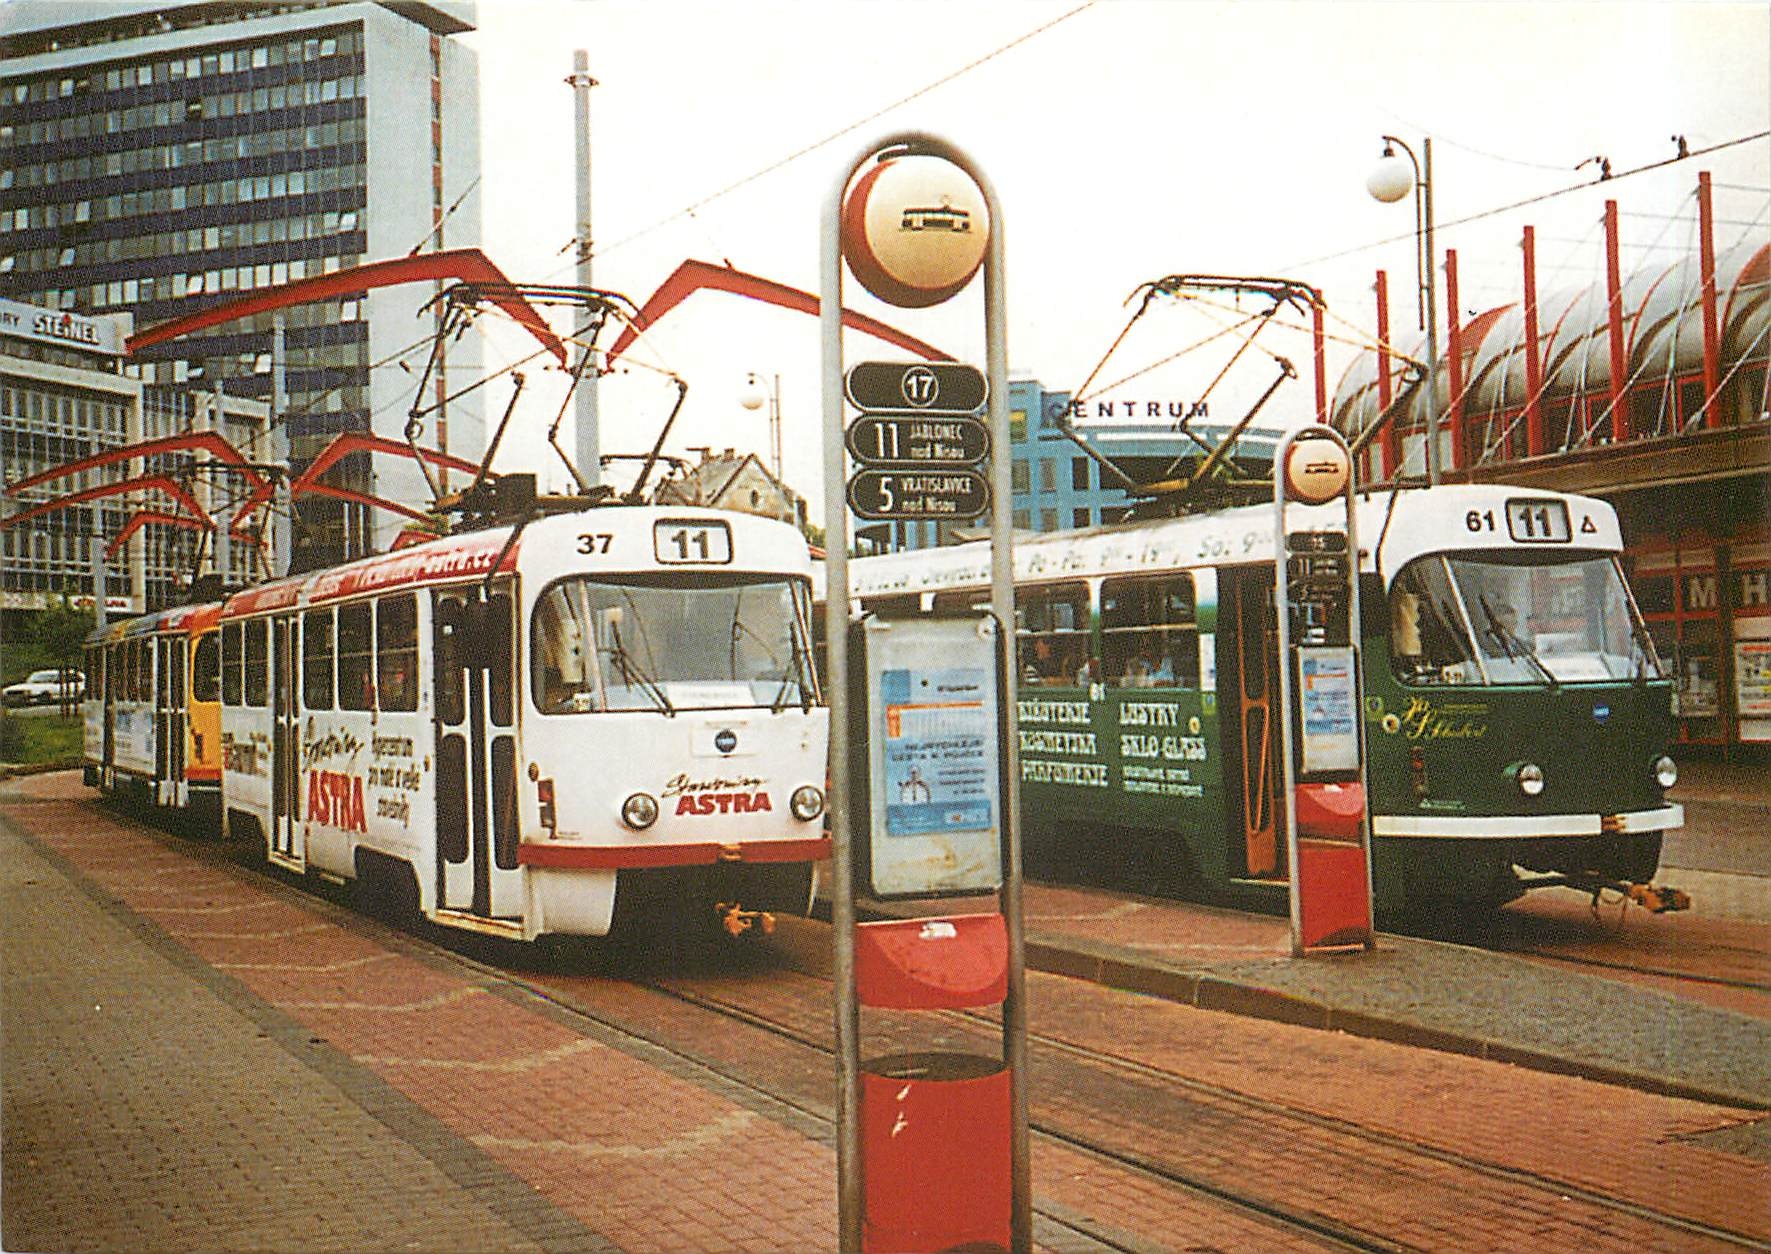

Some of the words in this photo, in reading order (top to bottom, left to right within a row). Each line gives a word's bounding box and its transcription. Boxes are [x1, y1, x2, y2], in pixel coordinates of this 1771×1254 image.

[33, 312, 100, 346] STEINEL
[906, 376, 933, 399] 17
[875, 423, 899, 458] 11
[910, 424, 963, 440] JABLONEC
[879, 477, 894, 512] 5
[1466, 510, 1496, 533] 61
[1518, 507, 1554, 538] 11
[576, 533, 615, 555] 37
[670, 529, 710, 560] 11
[308, 769, 368, 833] ASTRA
[675, 792, 773, 817] ASTRA
